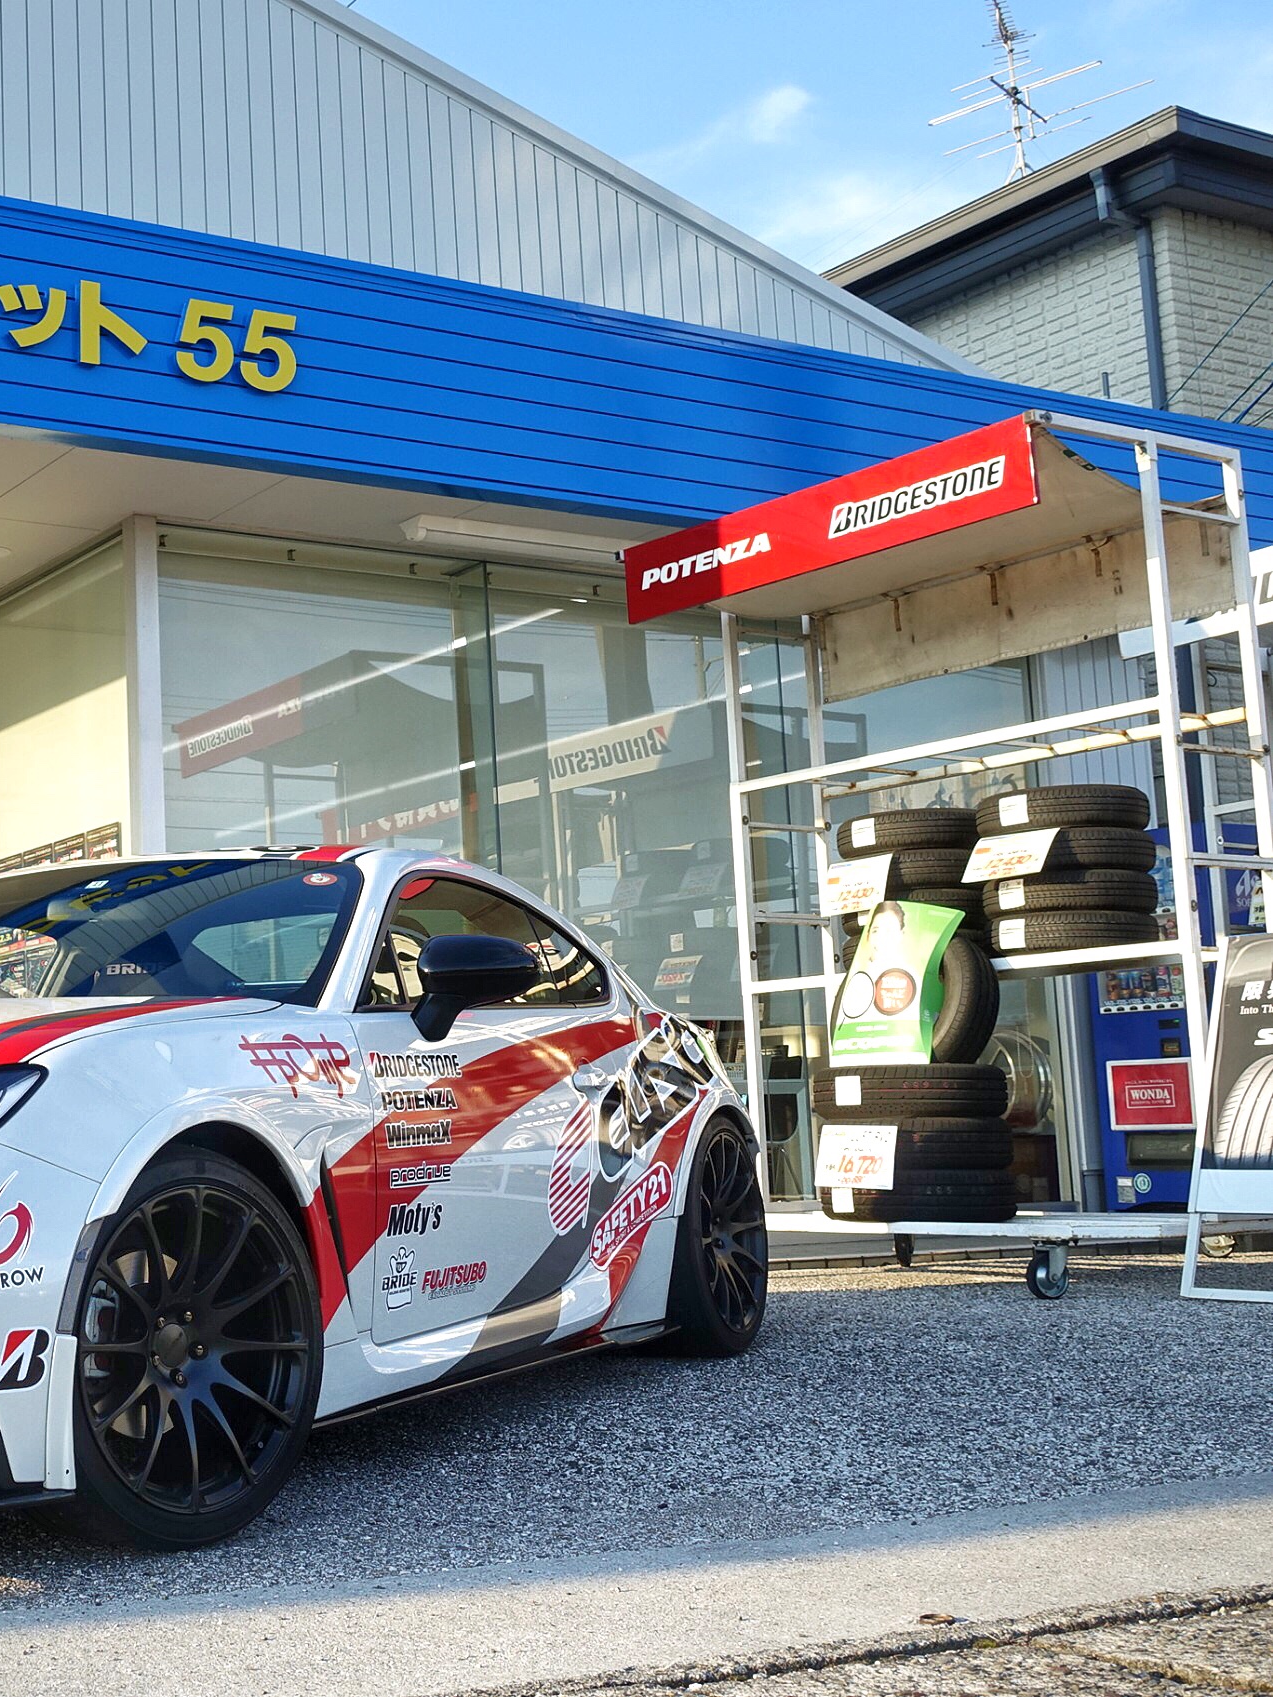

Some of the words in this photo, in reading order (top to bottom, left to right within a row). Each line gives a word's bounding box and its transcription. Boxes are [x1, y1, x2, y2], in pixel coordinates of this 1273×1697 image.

[175, 298, 298, 392] 55
[641, 532, 772, 591] POTENZA
[829, 456, 1005, 538] BRIDGESTONE
[1239, 1005, 1259, 1015] Into
[370, 1053, 461, 1078] BRIDGESTONE
[381, 1090, 457, 1111] POTENZA
[1130, 1088, 1170, 1100] WONDA
[382, 1271, 418, 1291] BRIDE
[421, 1261, 487, 1293] FUJITSUBO
